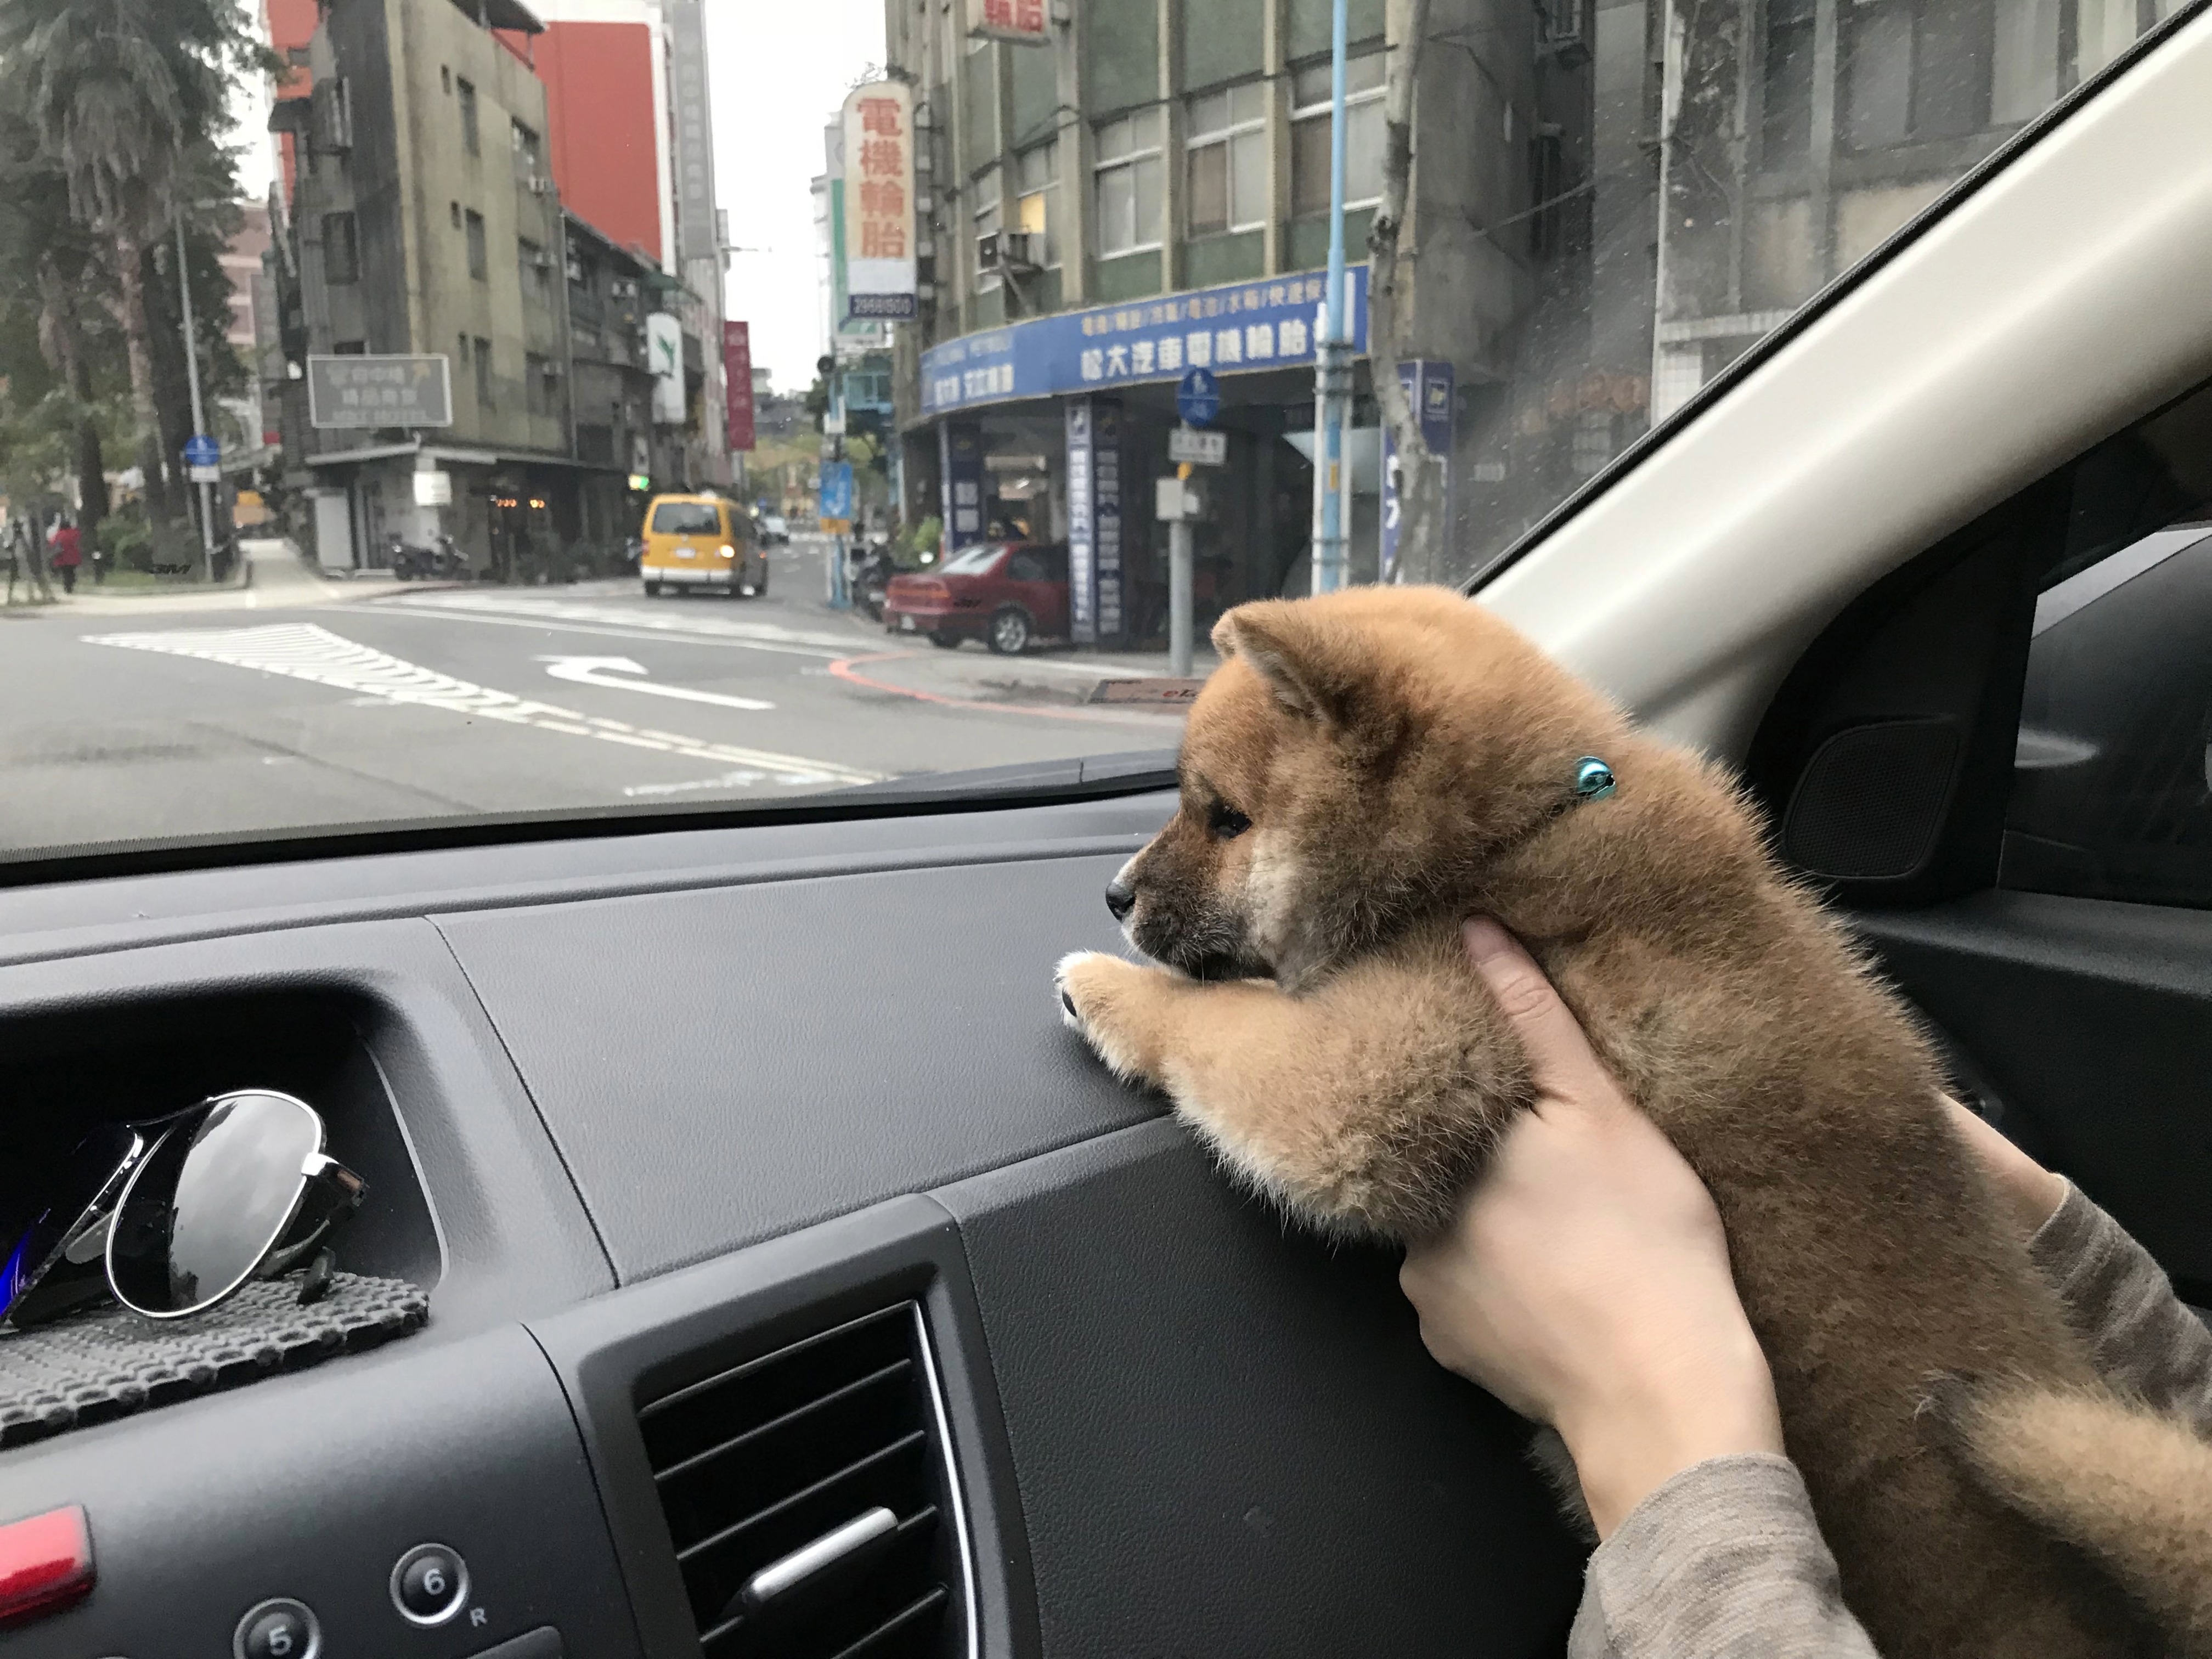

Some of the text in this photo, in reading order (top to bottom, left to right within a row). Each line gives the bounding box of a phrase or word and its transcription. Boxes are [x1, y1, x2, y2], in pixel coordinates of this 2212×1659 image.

[857, 97, 906, 258] 電機輪胎
[424, 1567, 445, 1596] 6
[470, 1607, 488, 1627] R
[269, 1624, 292, 1656] 5
